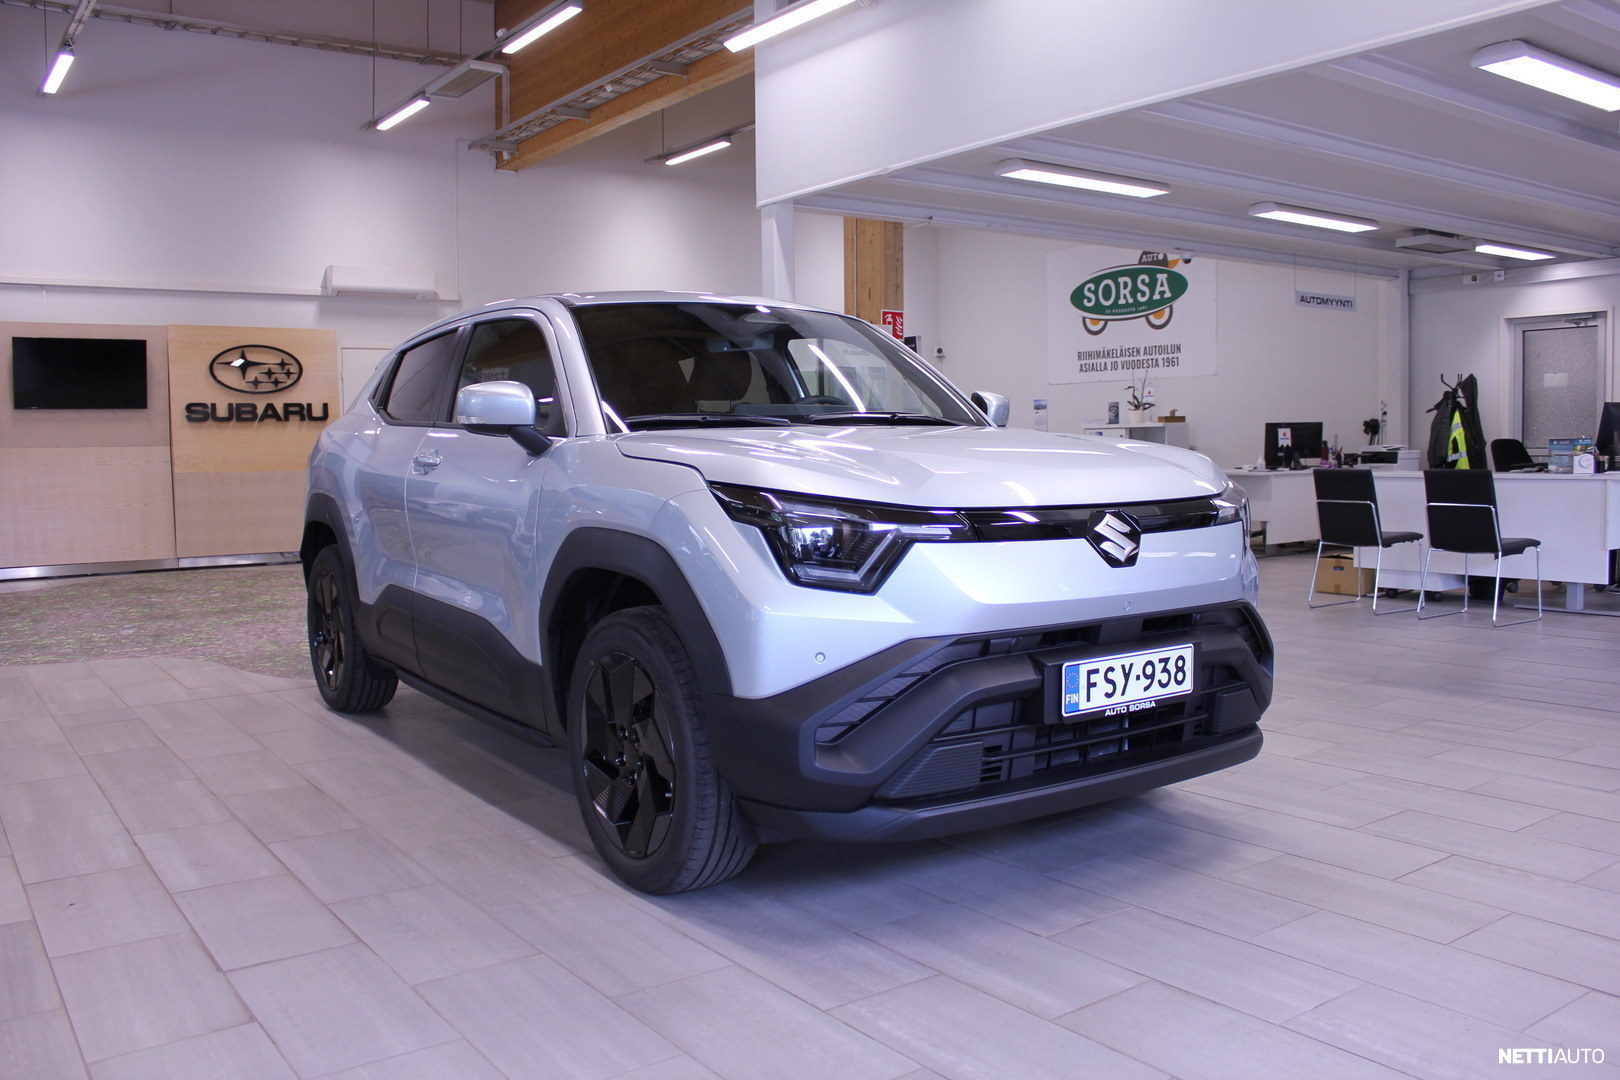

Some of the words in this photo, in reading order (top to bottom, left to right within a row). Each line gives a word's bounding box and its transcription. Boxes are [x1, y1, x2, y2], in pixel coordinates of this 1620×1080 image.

[1083, 273, 1172, 307] SORSA
[1299, 295, 1353, 308] AUTOMYYNTI
[1077, 345, 1141, 361] RIIHIMÄKELÄISEN
[1143, 343, 1182, 357] AUTOILUN
[1079, 361, 1108, 373] ASIALLA
[1110, 361, 1119, 371] JO
[1121, 358, 1159, 371] VUODESTA
[1162, 356, 1180, 368] 1961
[185, 402, 329, 423] SUBARU
[1086, 654, 1187, 703] FSY-938
[1065, 692, 1079, 705] FIN
[1104, 706, 1128, 717] AUTO
[1128, 700, 1157, 712] SORSA
